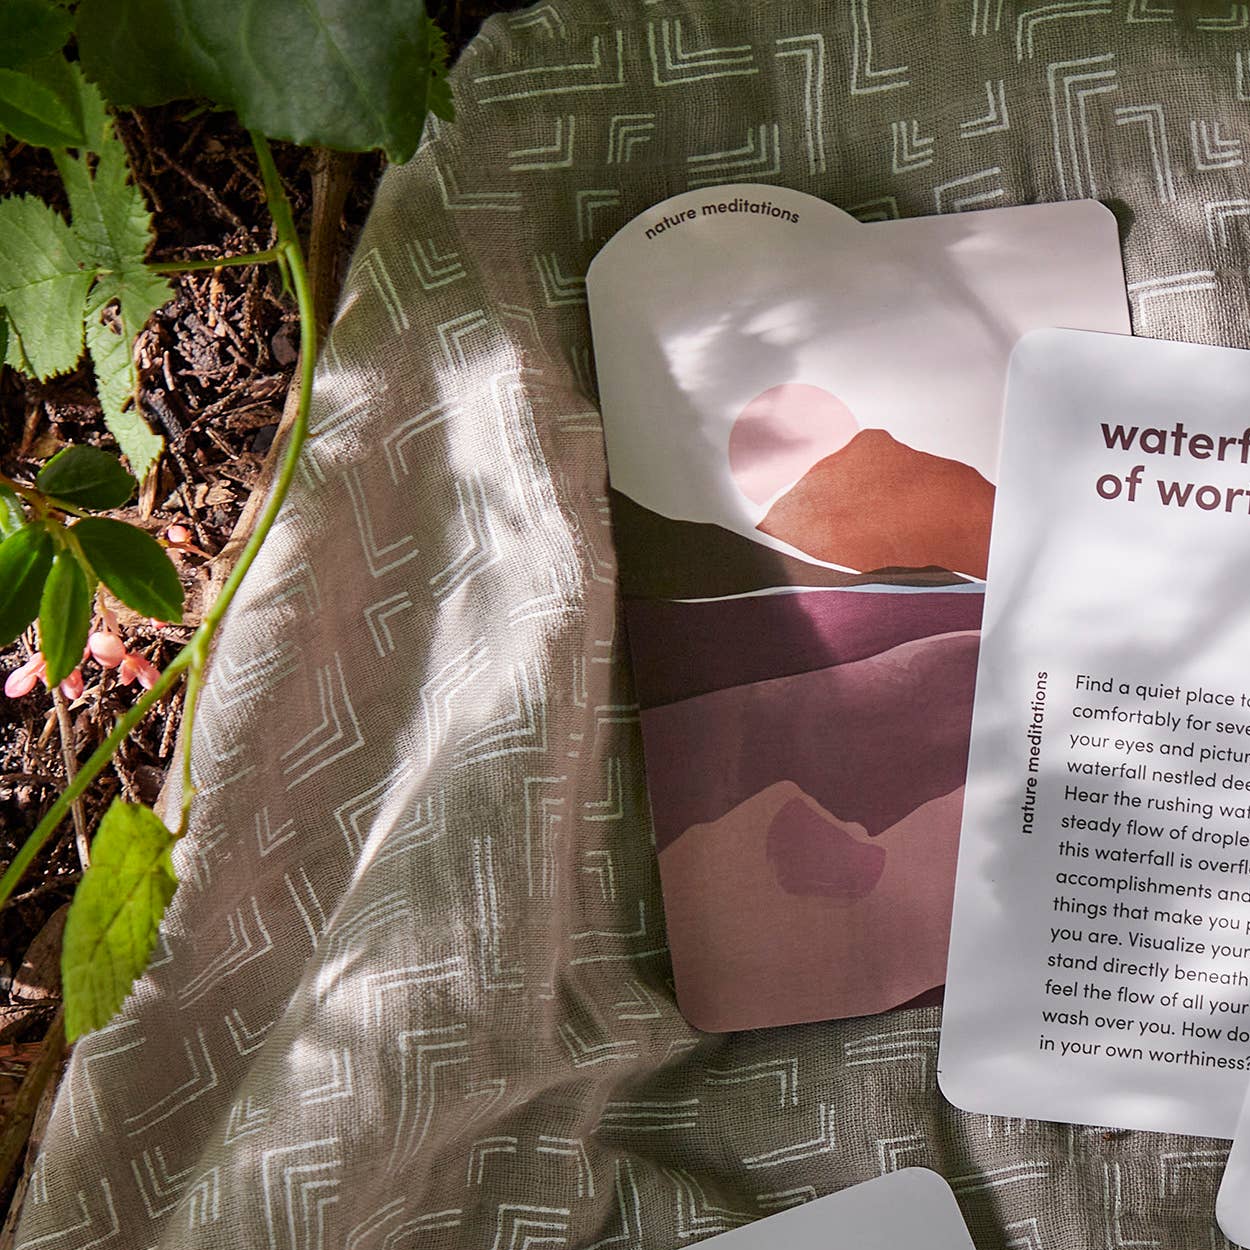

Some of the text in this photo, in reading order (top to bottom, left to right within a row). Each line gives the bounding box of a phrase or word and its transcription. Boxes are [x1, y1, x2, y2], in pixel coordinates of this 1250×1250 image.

[644, 198, 800, 240] nature meditations
[1095, 464, 1146, 503] of
[1075, 674, 1114, 694] Find
[1118, 683, 1131, 696] a
[1135, 683, 1182, 702] quiet
[1185, 687, 1236, 707] place
[1072, 705, 1182, 733] comfortably
[1185, 713, 1213, 732] for
[1021, 671, 1049, 835] nature meditations
[1066, 761, 1147, 781] waterfall
[1151, 769, 1217, 788] nestled
[1060, 813, 1122, 838] steady
[1125, 818, 1165, 838] flow
[1168, 824, 1189, 841] of
[1058, 840, 1090, 859] this
[1094, 847, 1175, 868] waterfall
[1179, 852, 1193, 870] is
[1050, 927, 1083, 944] you
[1087, 931, 1123, 947] are.
[1128, 930, 1206, 955] Visualize
[1047, 952, 1099, 972] stand
[1102, 956, 1170, 983] directly
[1174, 963, 1249, 987] beneath
[1039, 1034, 1055, 1052] in
[1060, 1040, 1102, 1057] your
[1105, 1045, 1143, 1060] own
